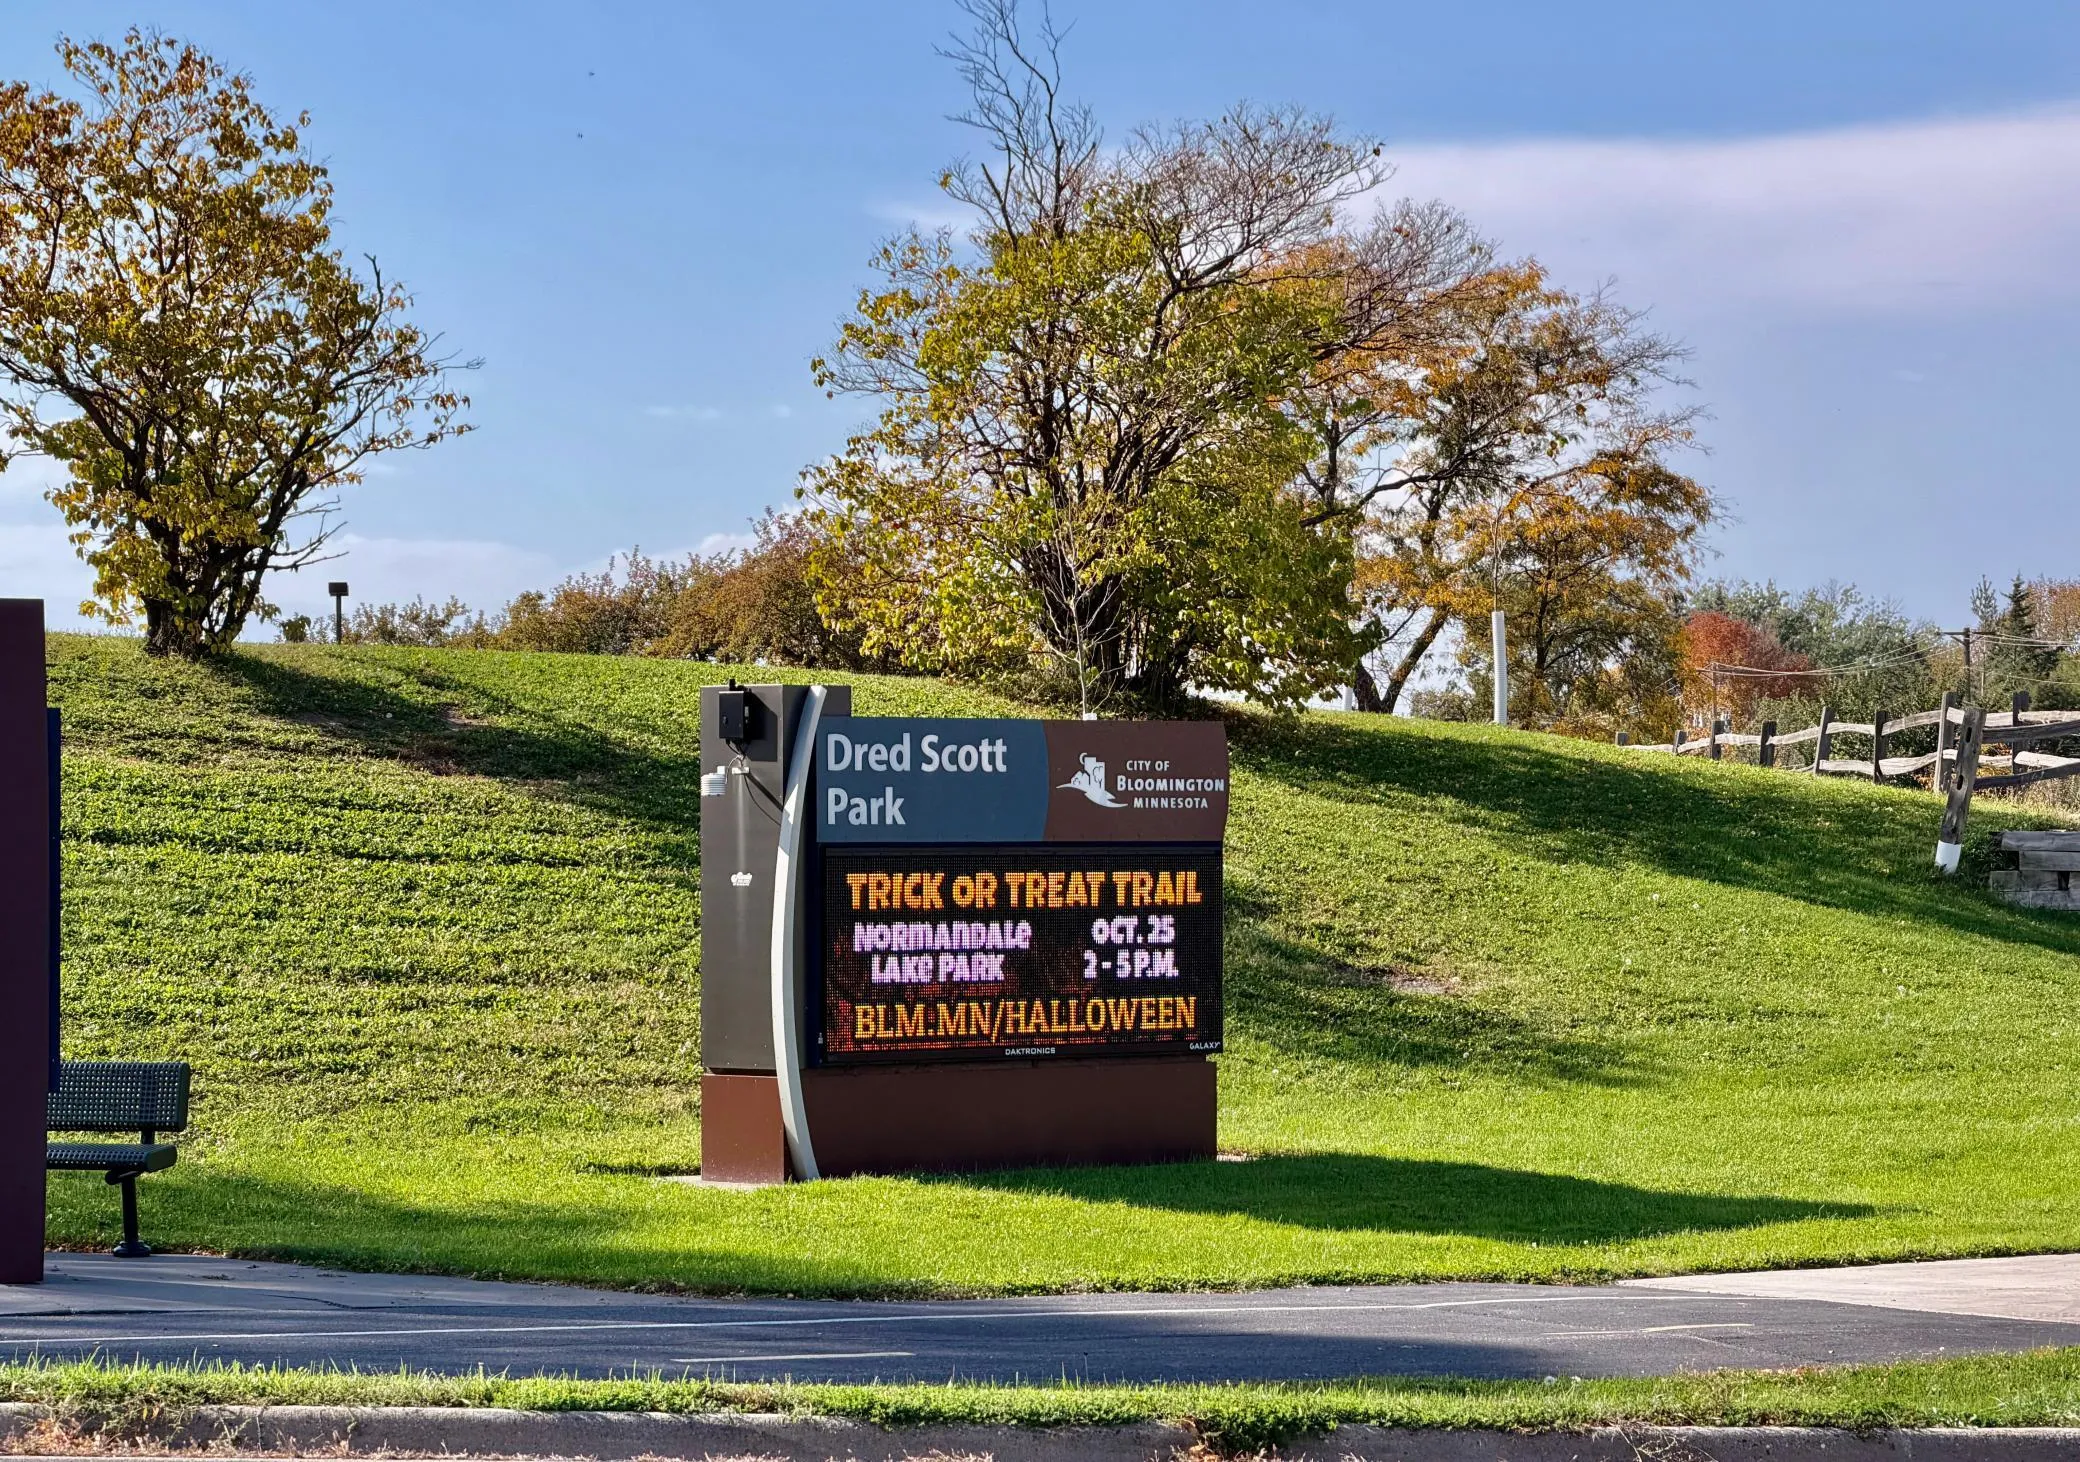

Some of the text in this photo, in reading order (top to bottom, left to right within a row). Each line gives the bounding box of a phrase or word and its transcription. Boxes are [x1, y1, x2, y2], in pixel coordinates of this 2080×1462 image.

[827, 732, 1008, 773] Dred Scott
[1126, 760, 1170, 772] CITY OF
[1117, 775, 1225, 791] BLOOMINGTON
[827, 786, 906, 826] Park
[1133, 797, 1208, 809] MINNESOTA
[846, 871, 1202, 910] TRICK OR TREAT TRAIL
[1091, 915, 1175, 944] OCT. 25
[938, 952, 1005, 982] PARK
[1005, 1047, 1056, 1056] DAKTRONICS
[1189, 1042, 1220, 1050] GALAXY
